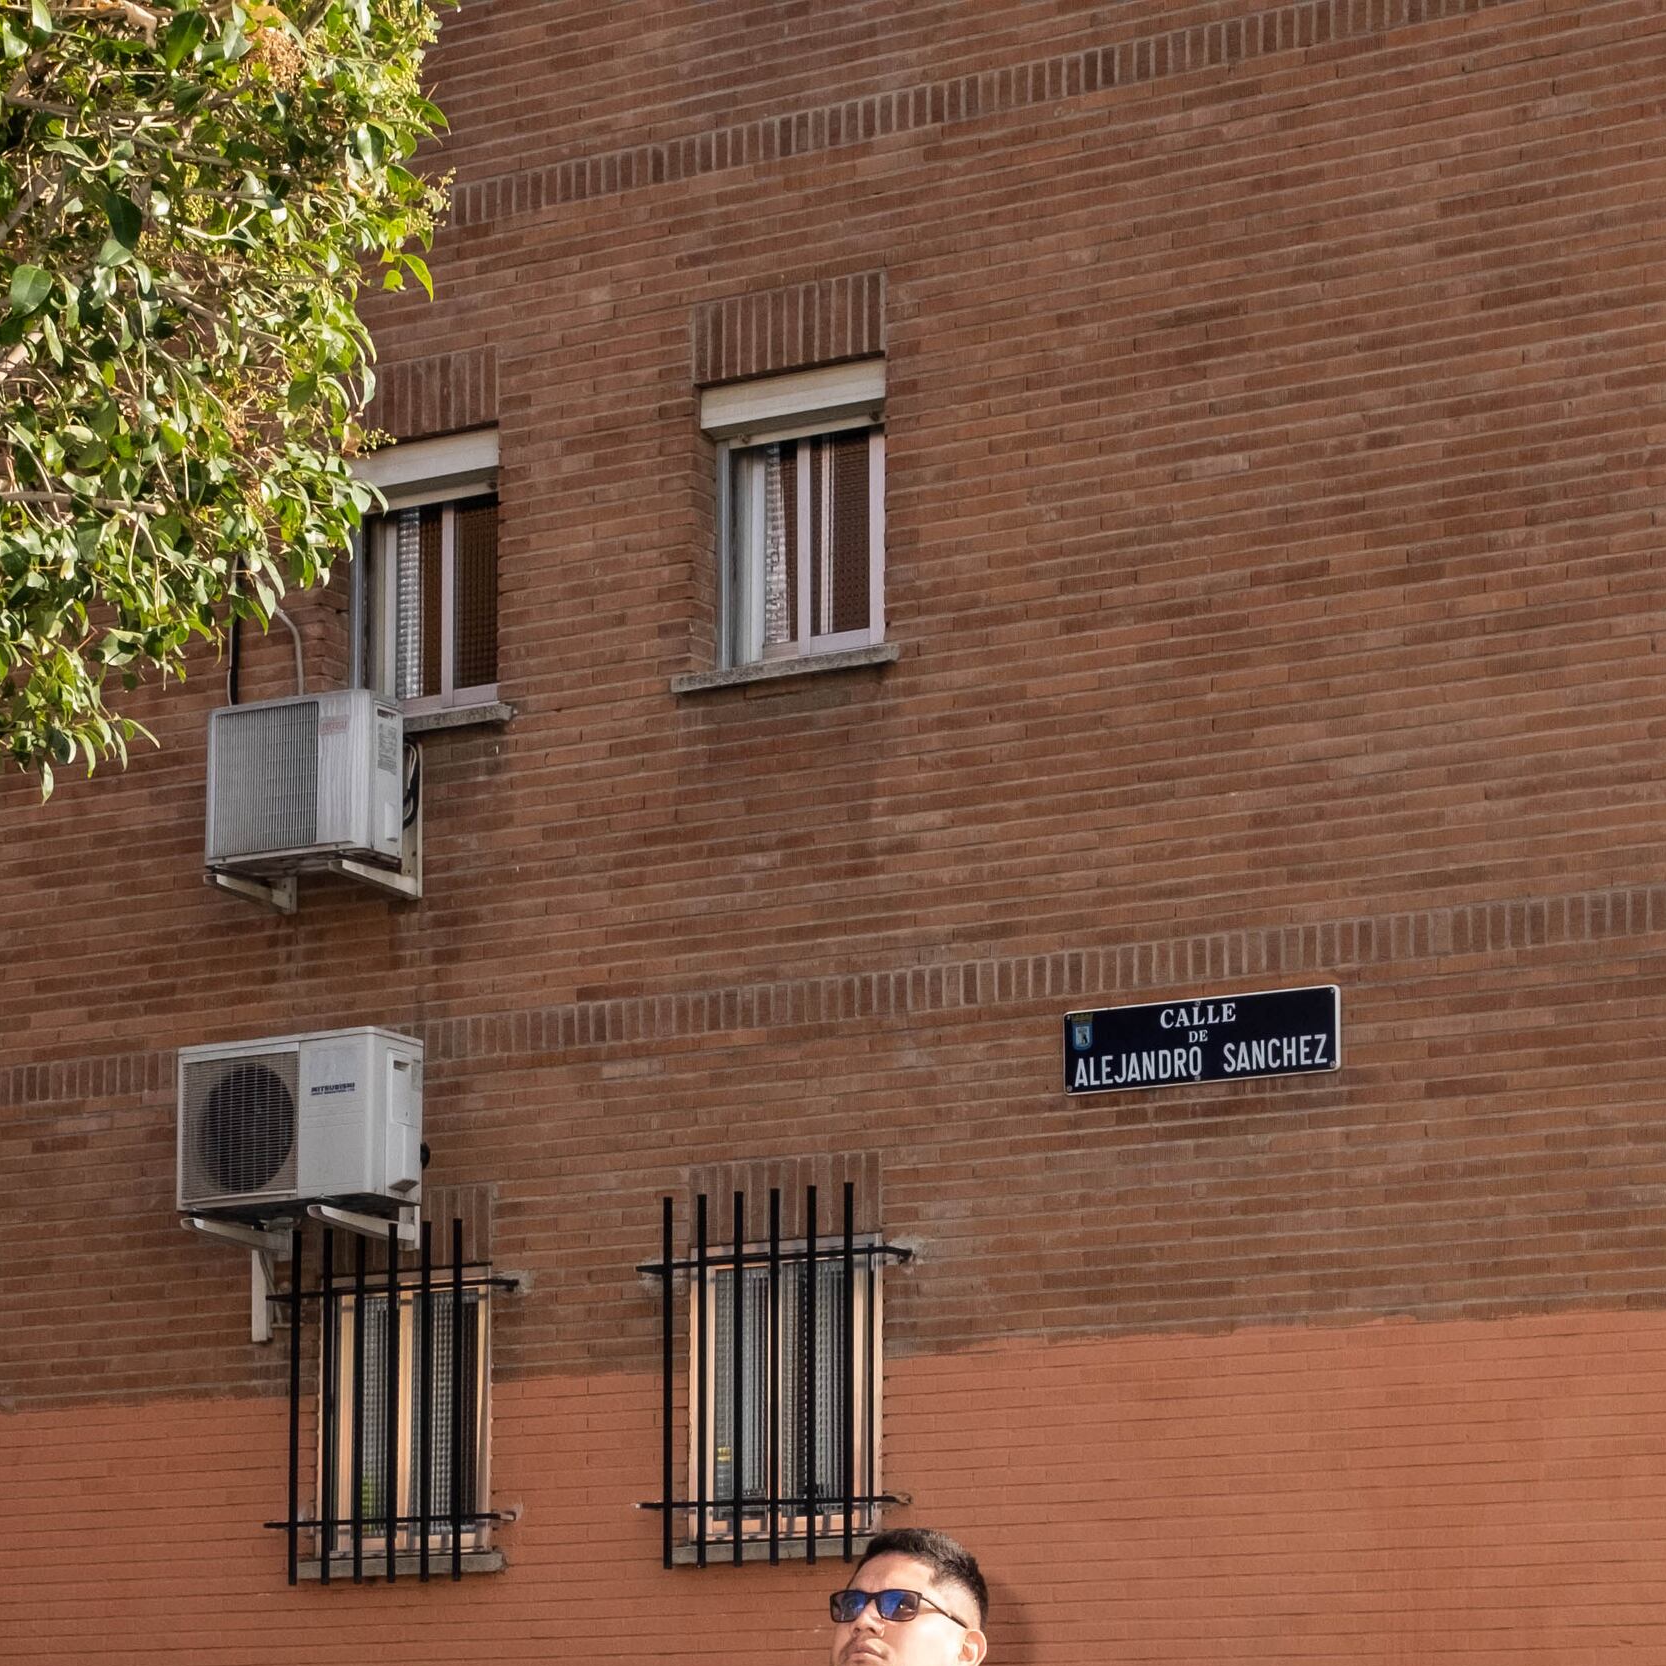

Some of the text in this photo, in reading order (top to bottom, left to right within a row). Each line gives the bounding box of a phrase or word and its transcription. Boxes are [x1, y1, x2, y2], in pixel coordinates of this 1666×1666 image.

[1160, 1002, 1237, 1029] CALLE
[1188, 1029, 1209, 1044] DE
[1074, 1033, 1328, 1088] ALEJANDRO SANCHEZ
